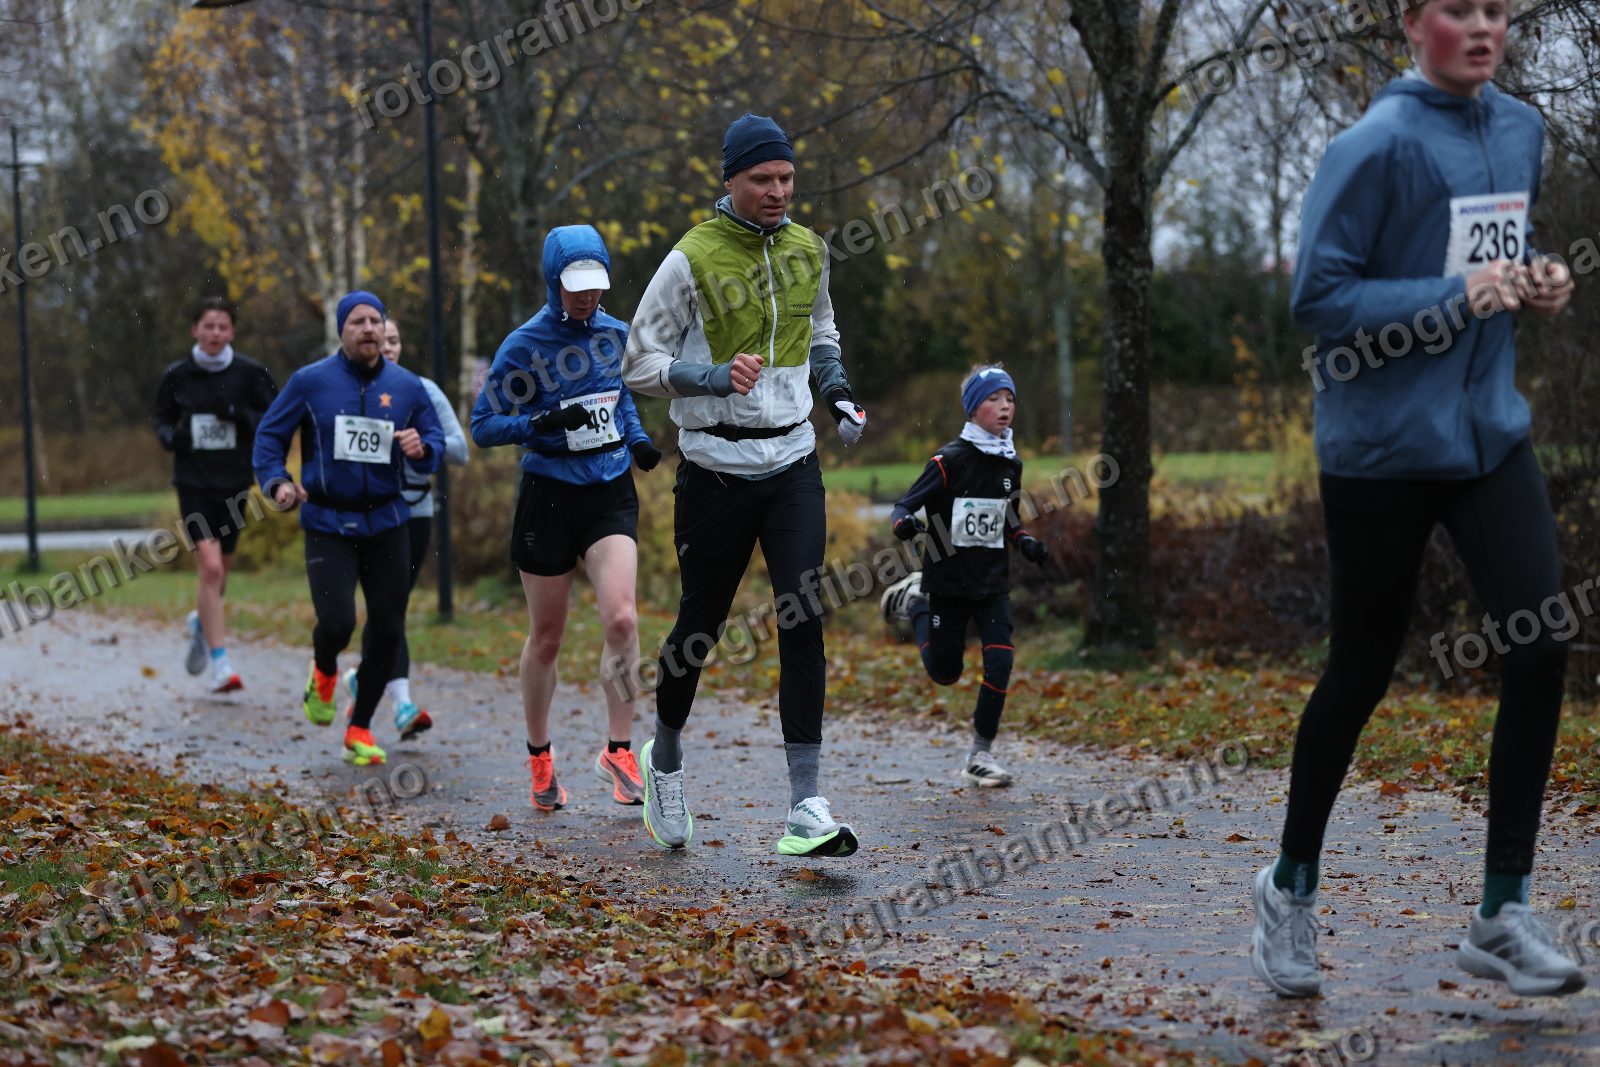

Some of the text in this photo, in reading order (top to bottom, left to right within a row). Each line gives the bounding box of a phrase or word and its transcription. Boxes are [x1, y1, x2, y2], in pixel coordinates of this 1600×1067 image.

[1467, 220, 1518, 263] 236
[346, 430, 380, 453] 769
[965, 512, 999, 537] 654
